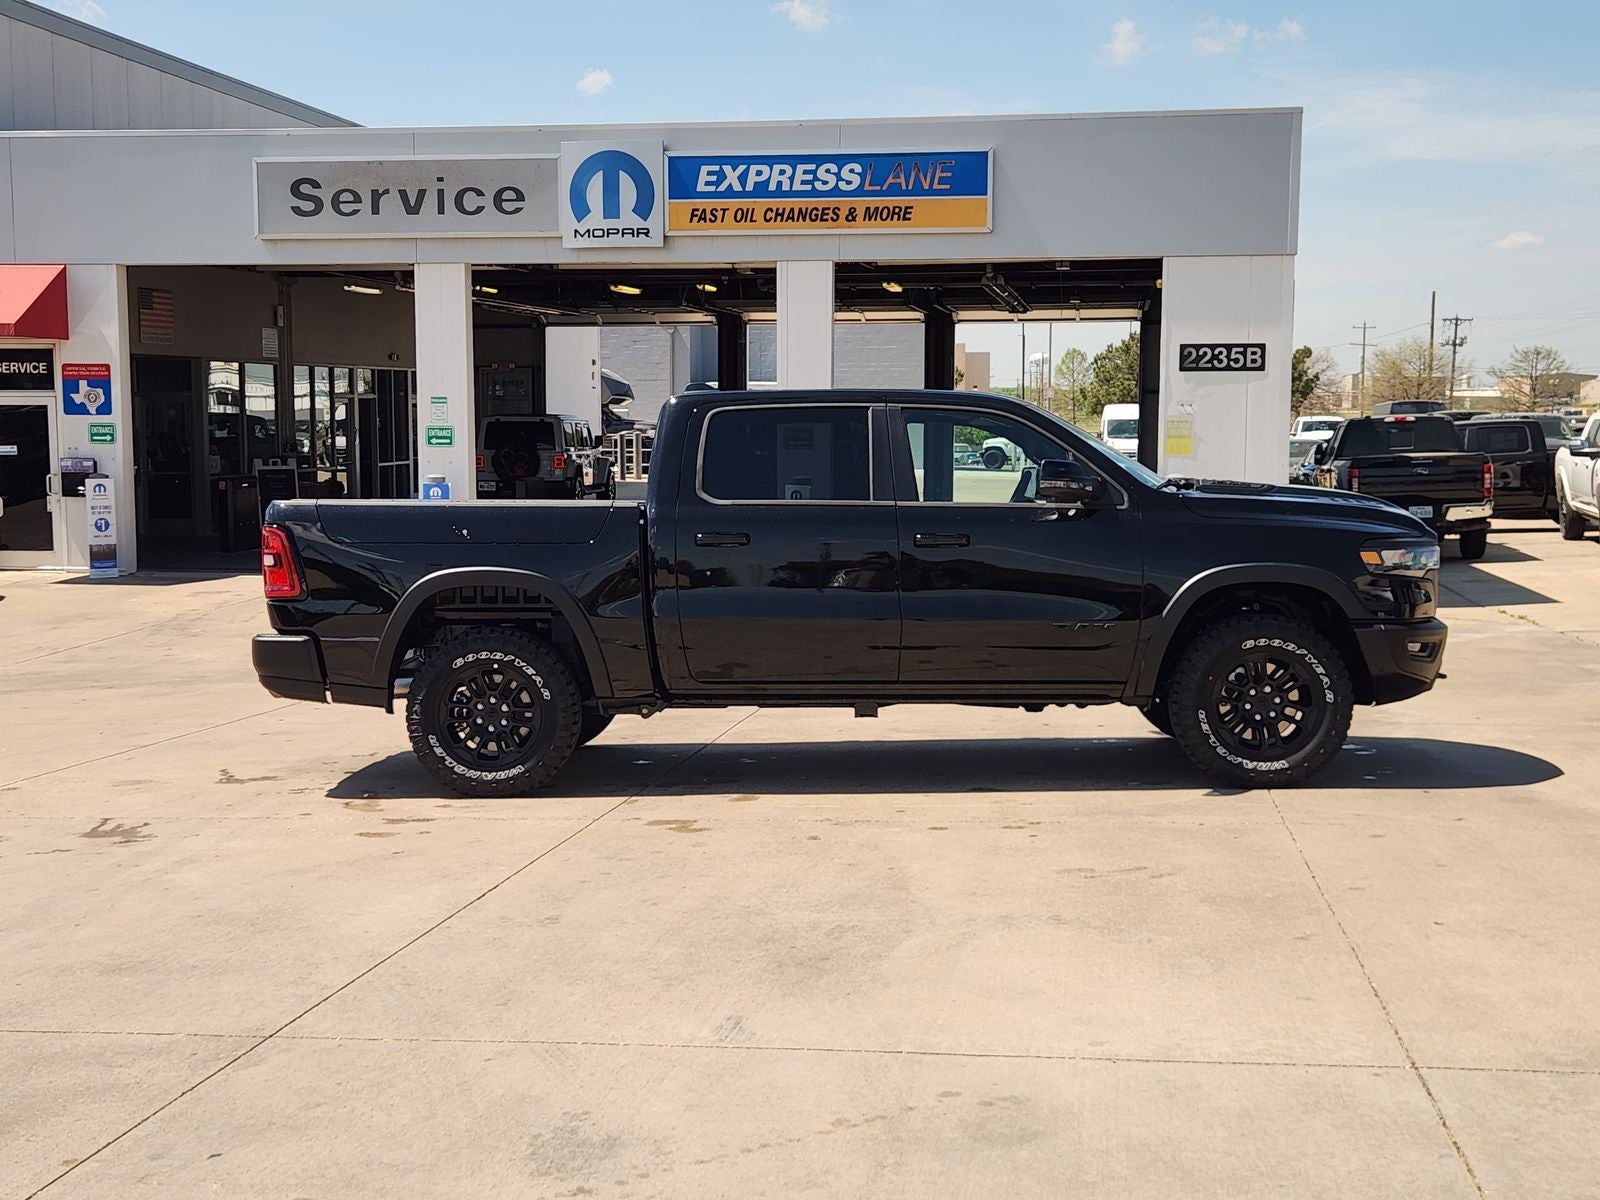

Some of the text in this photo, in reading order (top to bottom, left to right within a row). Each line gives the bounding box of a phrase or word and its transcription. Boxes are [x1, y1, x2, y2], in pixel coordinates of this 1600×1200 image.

[289, 176, 526, 218] Service
[688, 205, 914, 224] FAST OIL CHANGES & MORE
[573, 227, 652, 240] MOPAR
[1182, 347, 1262, 368] 2235B
[0, 362, 48, 374] ERVICE
[91, 426, 114, 434] ENTRANCE
[428, 429, 452, 437] ENTRANCE
[452, 651, 551, 701] GOODYEAR
[1241, 638, 1335, 703] GOODYEAR
[427, 734, 525, 781] WRANGLER
